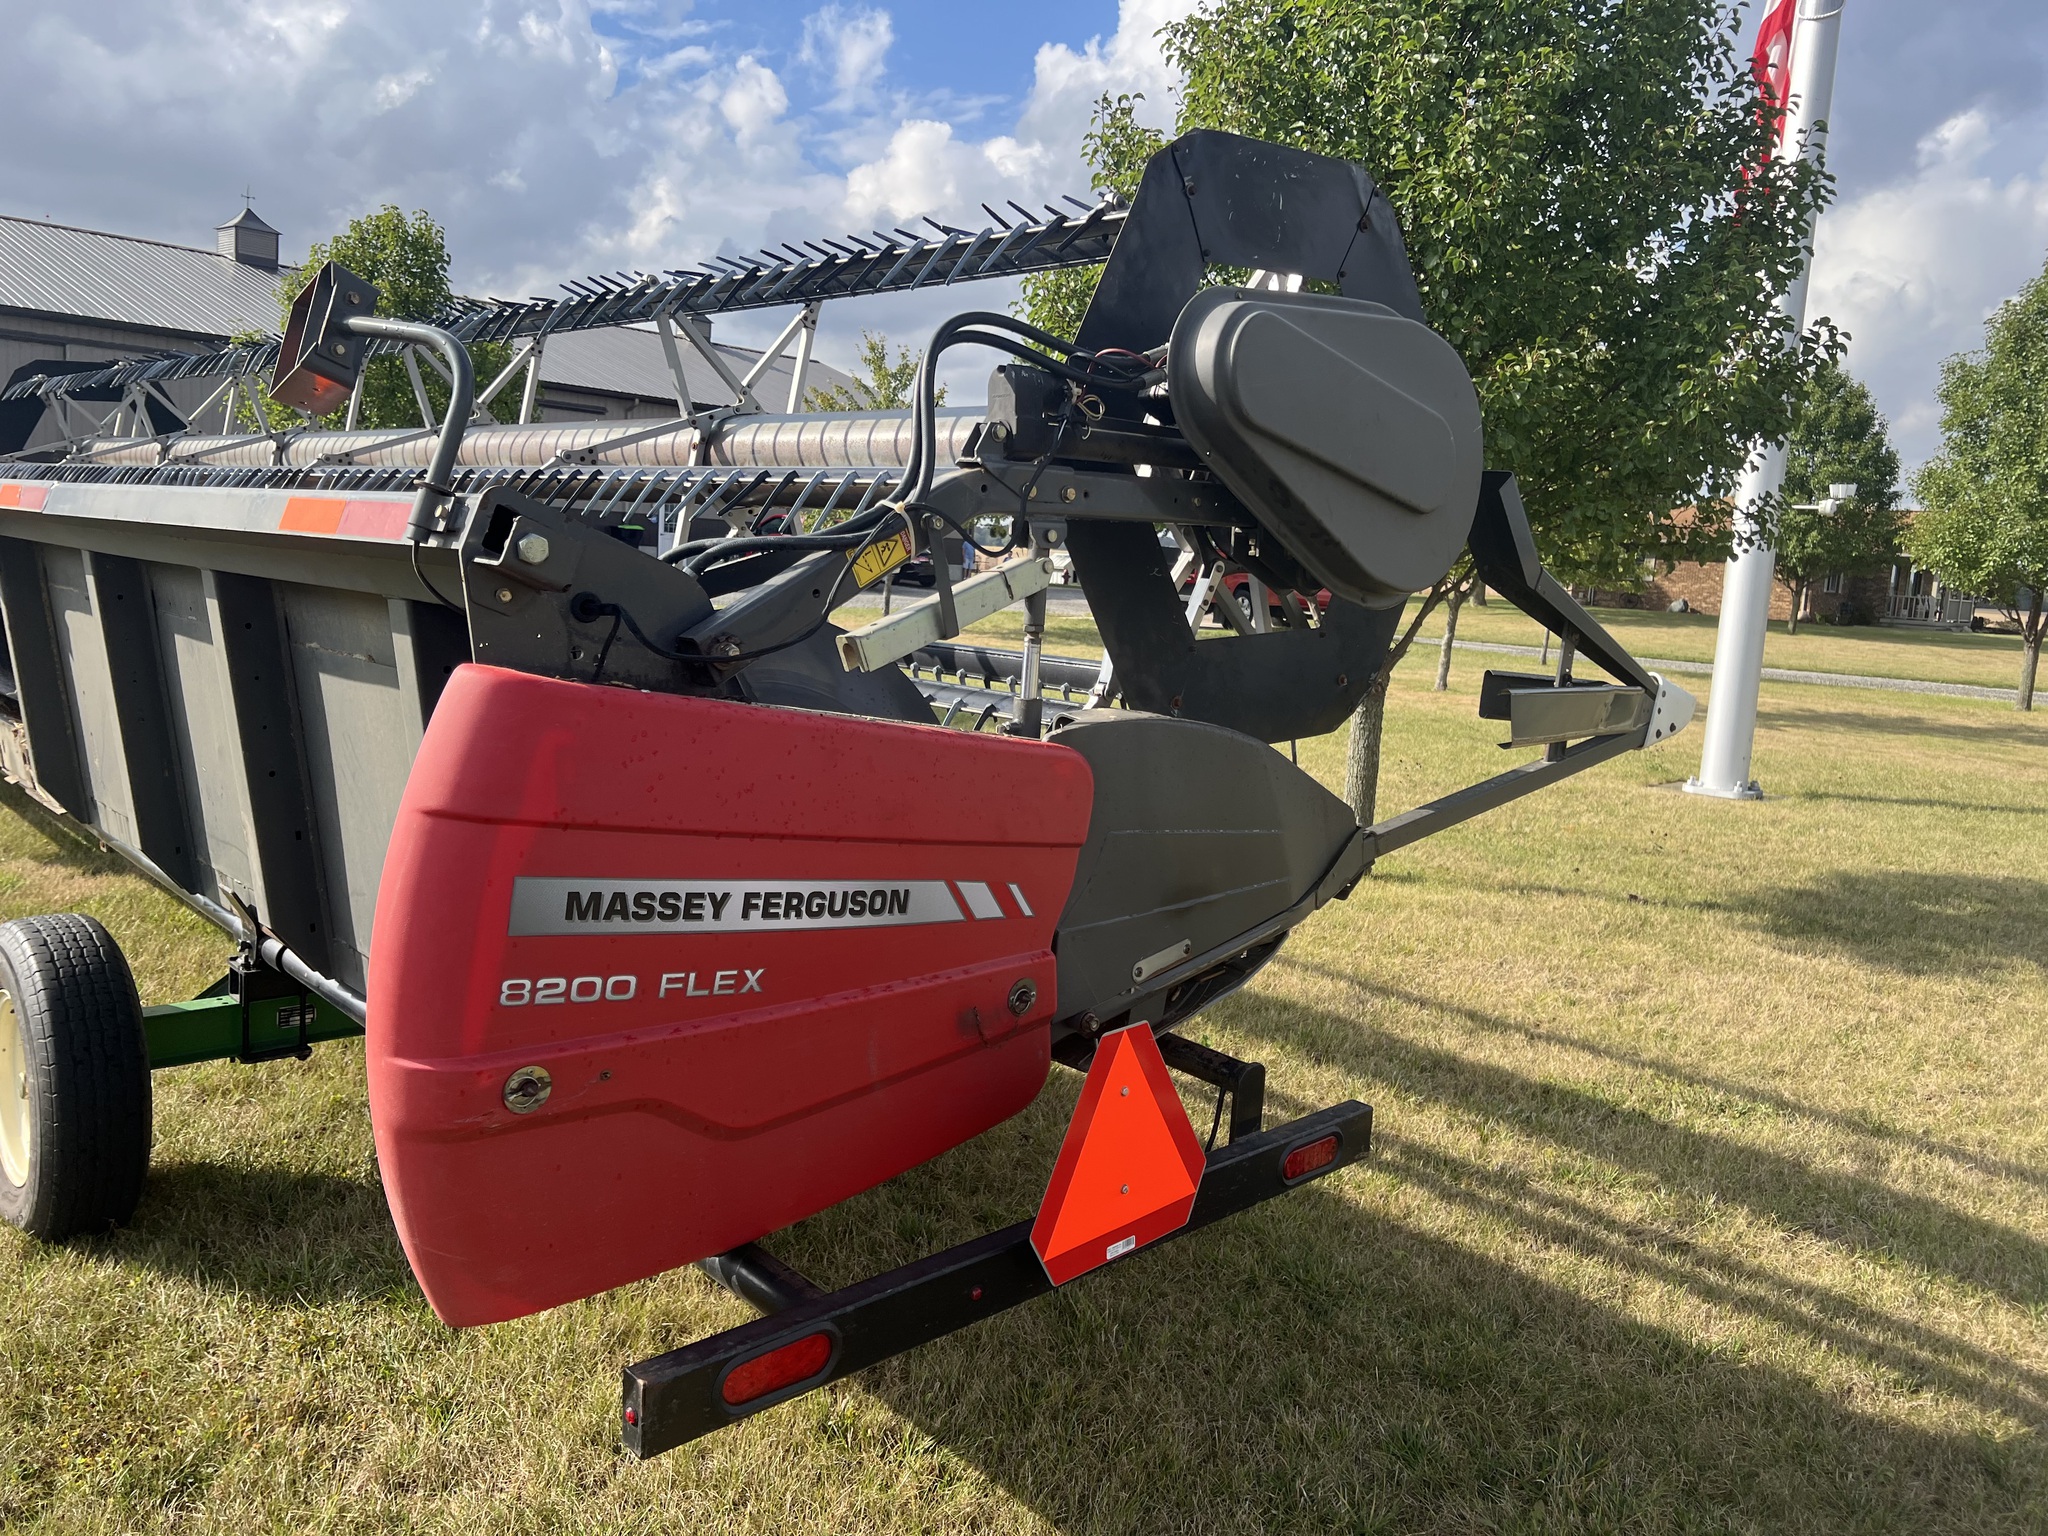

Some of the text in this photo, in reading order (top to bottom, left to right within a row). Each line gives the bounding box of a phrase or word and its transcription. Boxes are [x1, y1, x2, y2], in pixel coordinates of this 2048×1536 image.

[900, 530, 911, 552] DANGER
[564, 889, 911, 923] MASSEY FERGUSON
[499, 968, 767, 1006] 8200 FLEX
